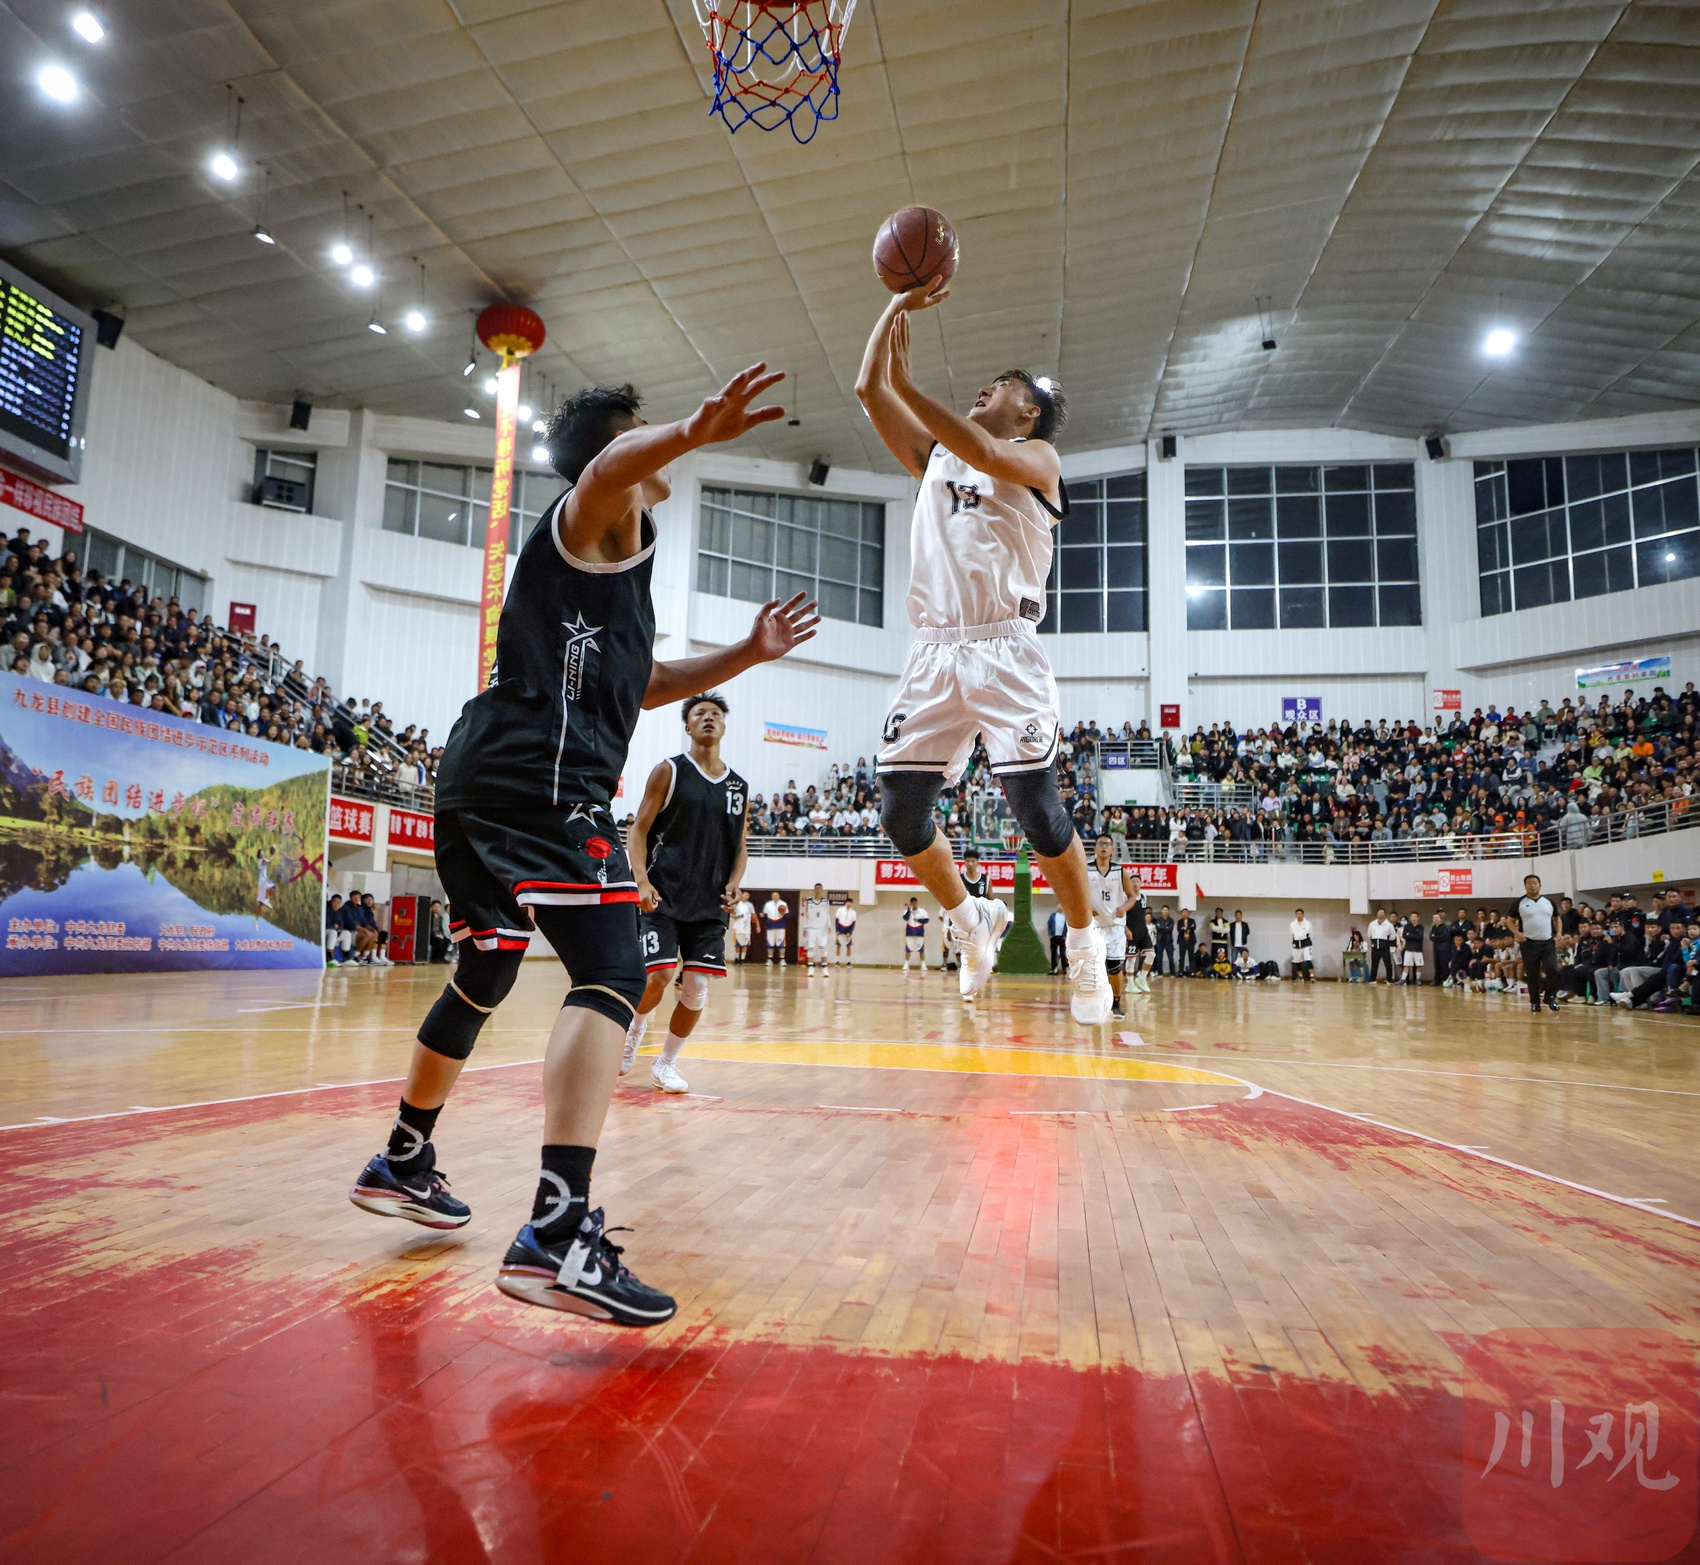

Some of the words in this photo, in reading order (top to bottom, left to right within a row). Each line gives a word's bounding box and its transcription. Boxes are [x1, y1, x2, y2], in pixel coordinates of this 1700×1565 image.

[945, 480, 981, 514] 13
[567, 643, 579, 701] LI-NING
[1284, 709, 1319, 721] 观众区
[1296, 698, 1307, 710] B
[12, 687, 270, 767] 九龙县创建全国民族团结进步示范区系列活动
[726, 791, 744, 816] 13
[330, 805, 372, 836] 篮球赛
[1101, 890, 1111, 902] 15
[641, 931, 660, 958] 13
[1128, 945, 1137, 954] 22
